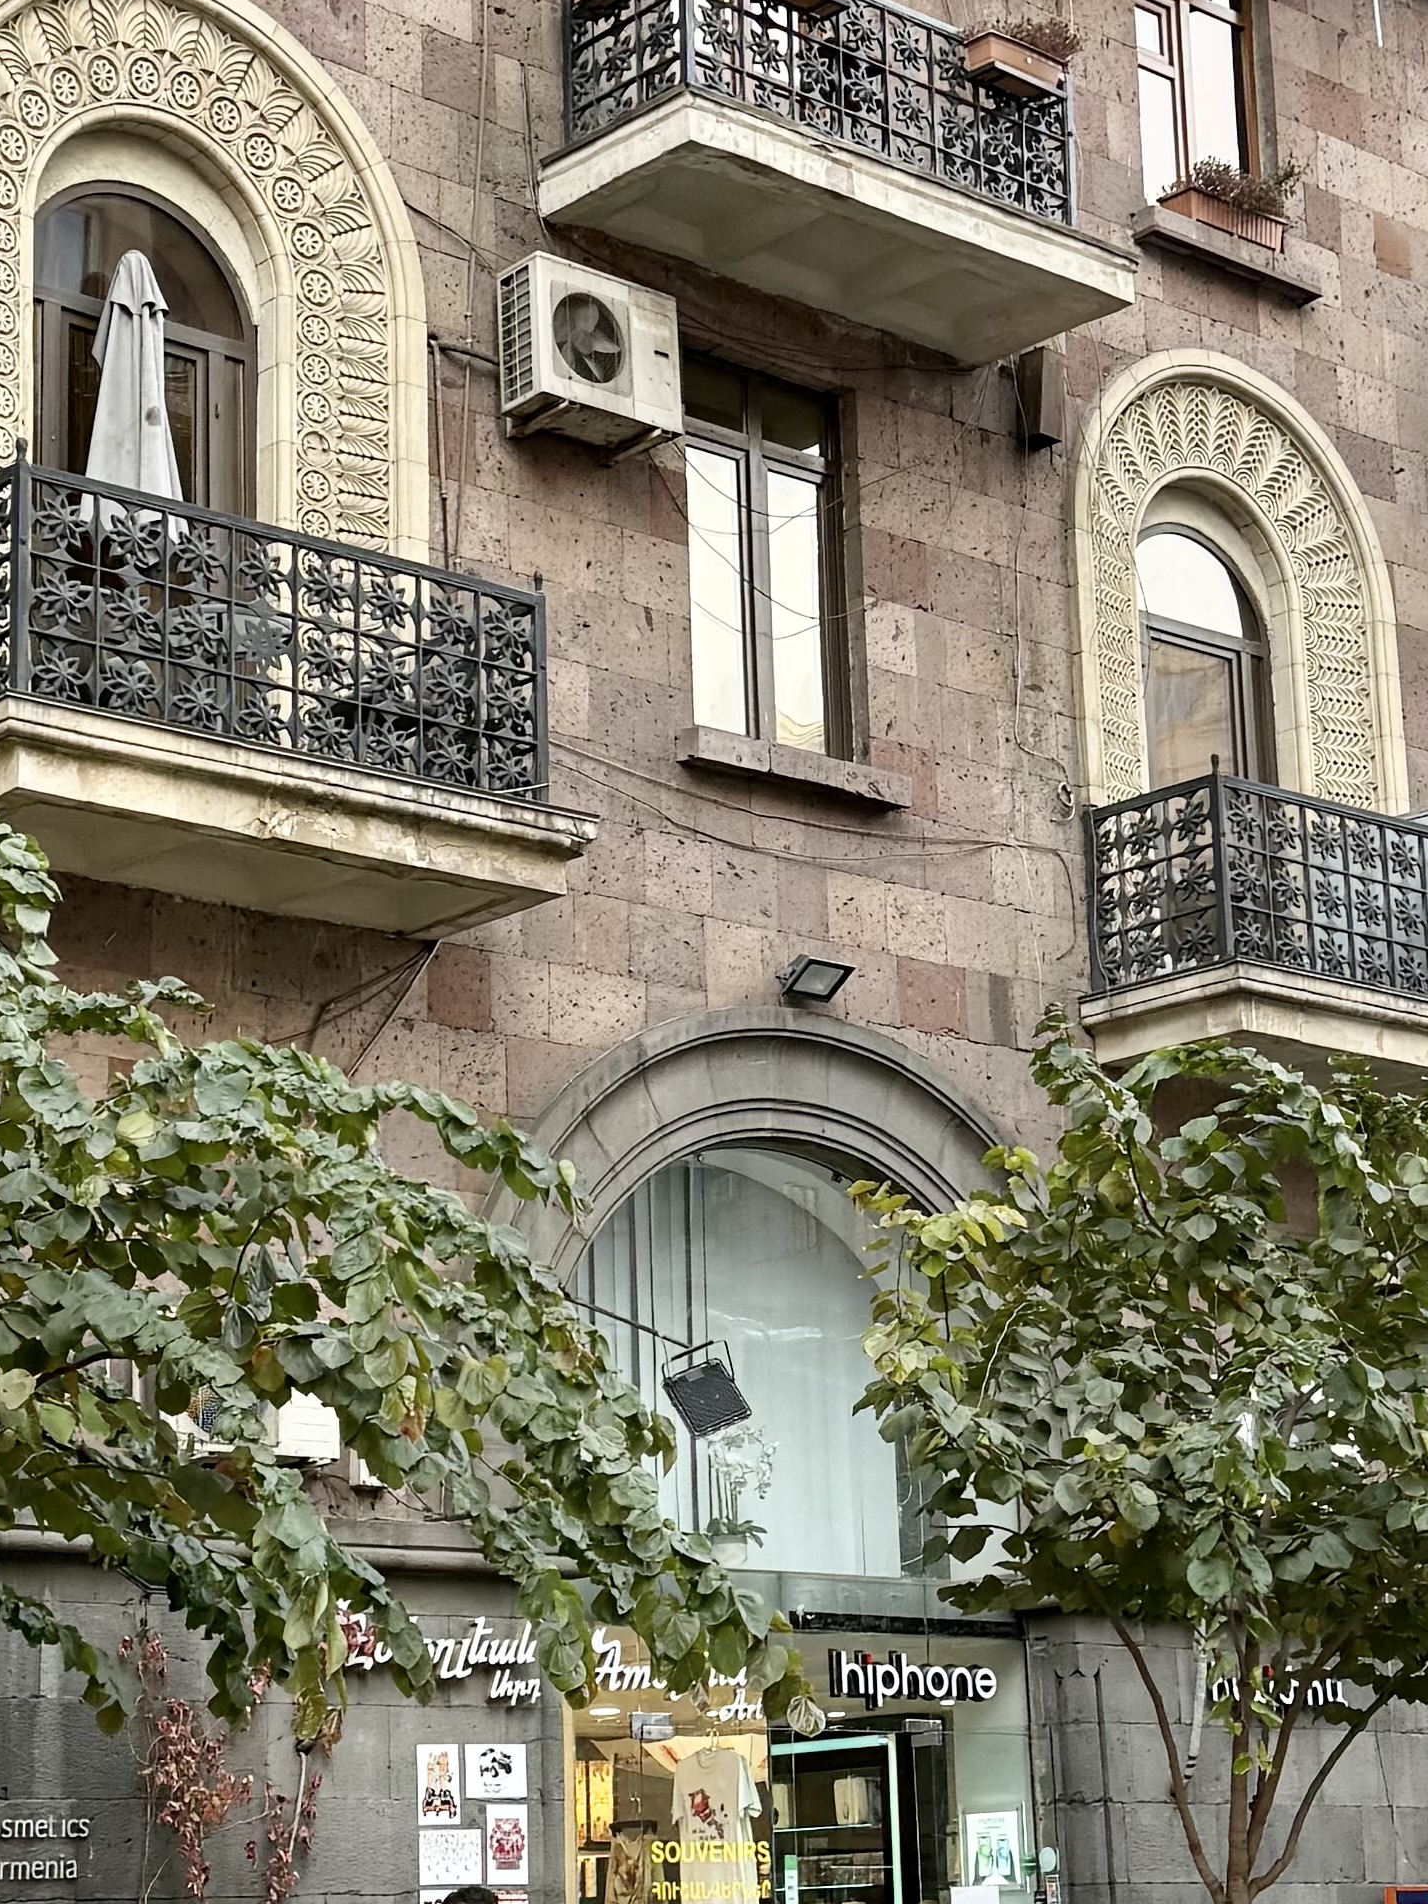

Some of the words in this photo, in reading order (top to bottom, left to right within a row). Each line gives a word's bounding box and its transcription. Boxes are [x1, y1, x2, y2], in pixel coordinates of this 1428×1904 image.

[840, 1650, 997, 1707] hiphone
[718, 1687, 764, 1722] Art
[651, 1840, 771, 1864] SOUVENIRS
